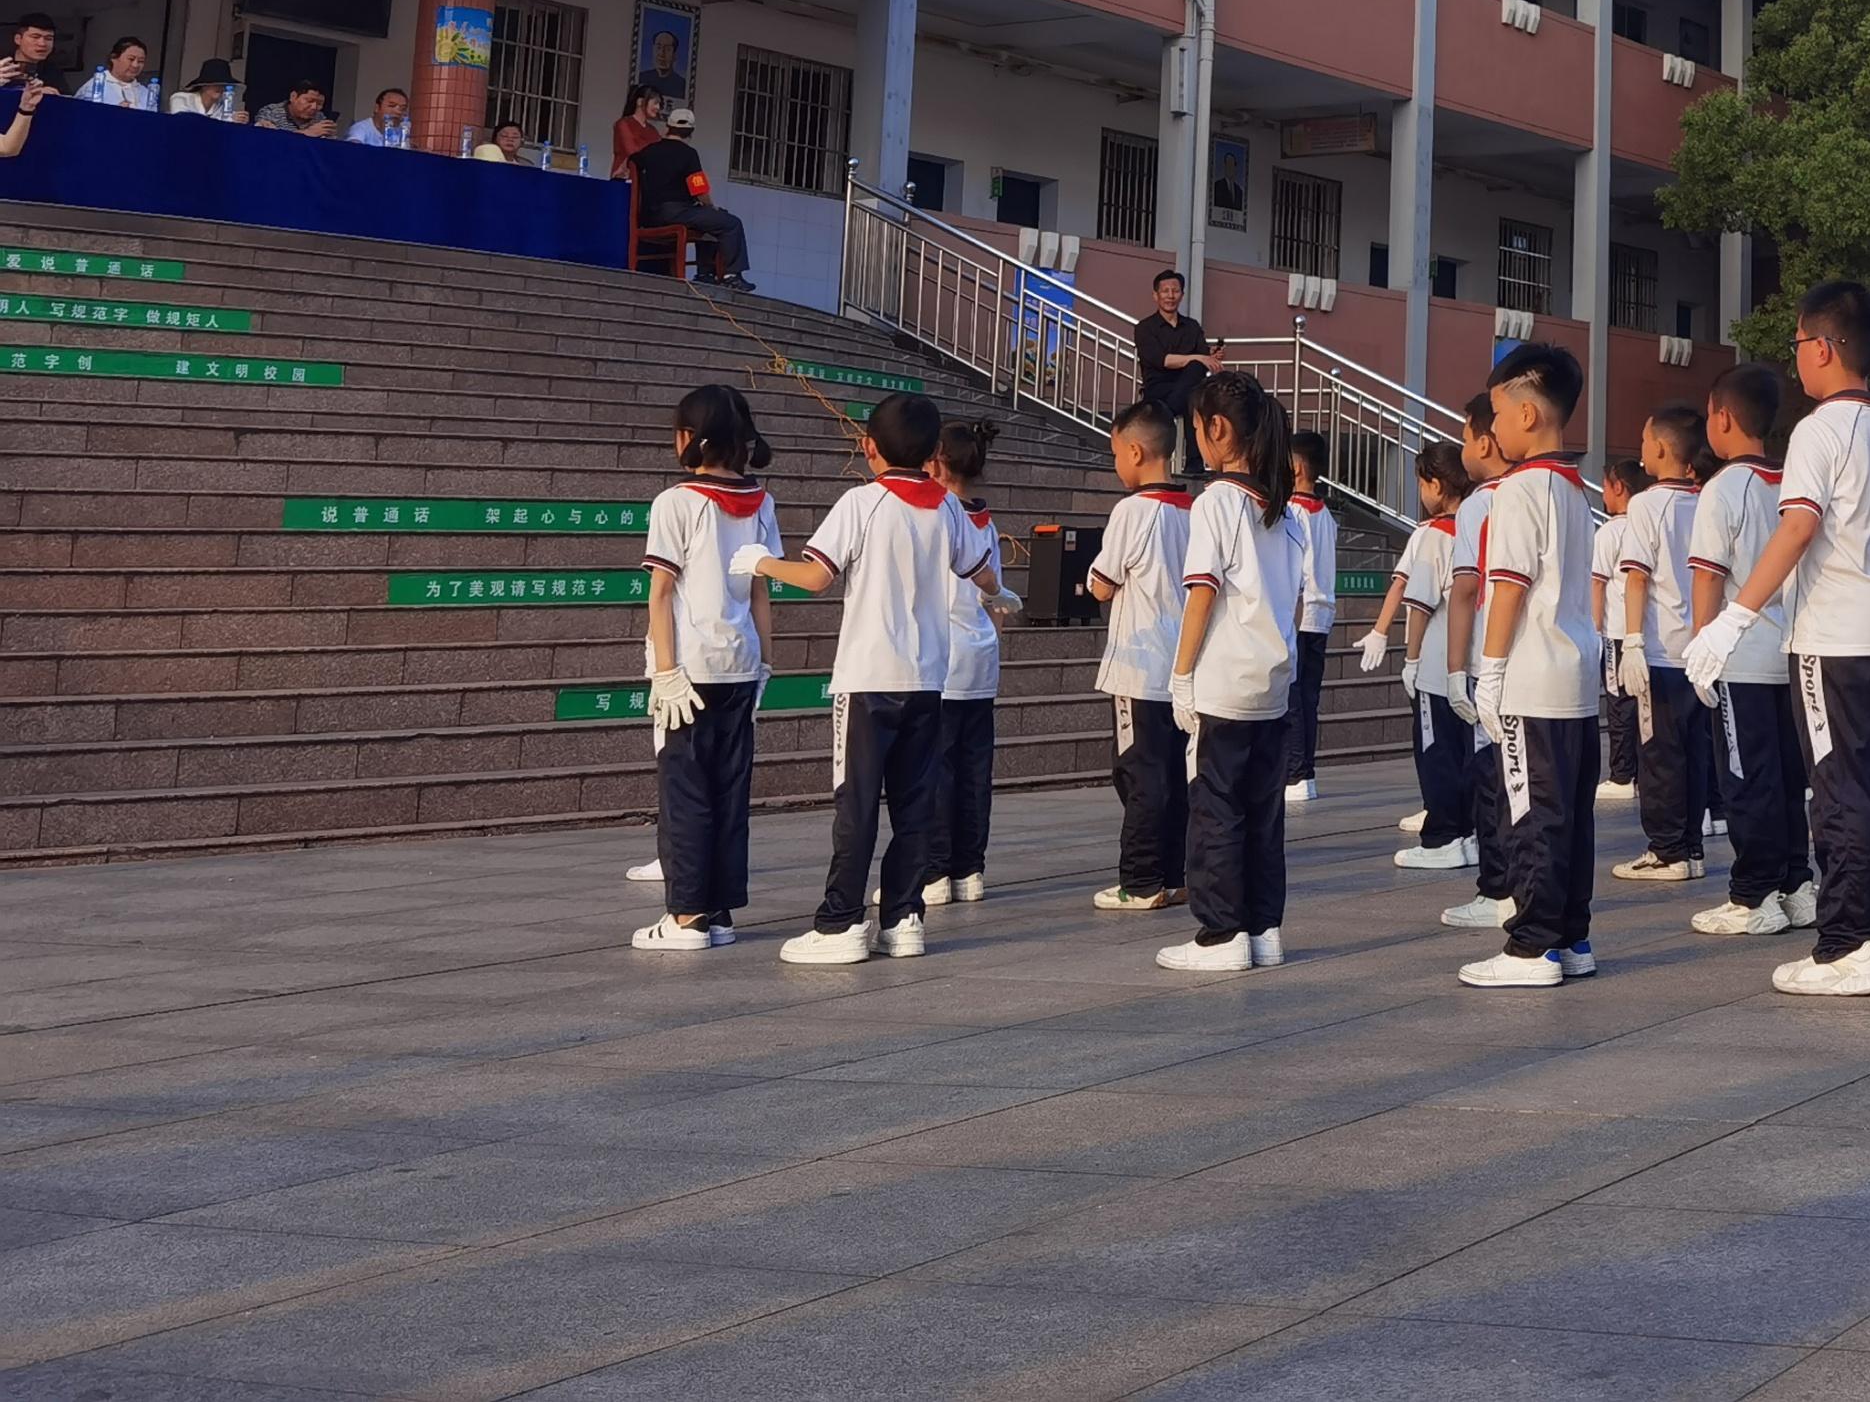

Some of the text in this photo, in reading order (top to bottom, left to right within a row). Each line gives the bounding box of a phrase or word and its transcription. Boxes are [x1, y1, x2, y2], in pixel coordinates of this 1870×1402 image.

[51, 302, 129, 321] 写规范字
[321, 506, 430, 524] 说普通话
[426, 579, 606, 598] 为了美观请写规范字
[1503, 715, 1522, 777] Sport
